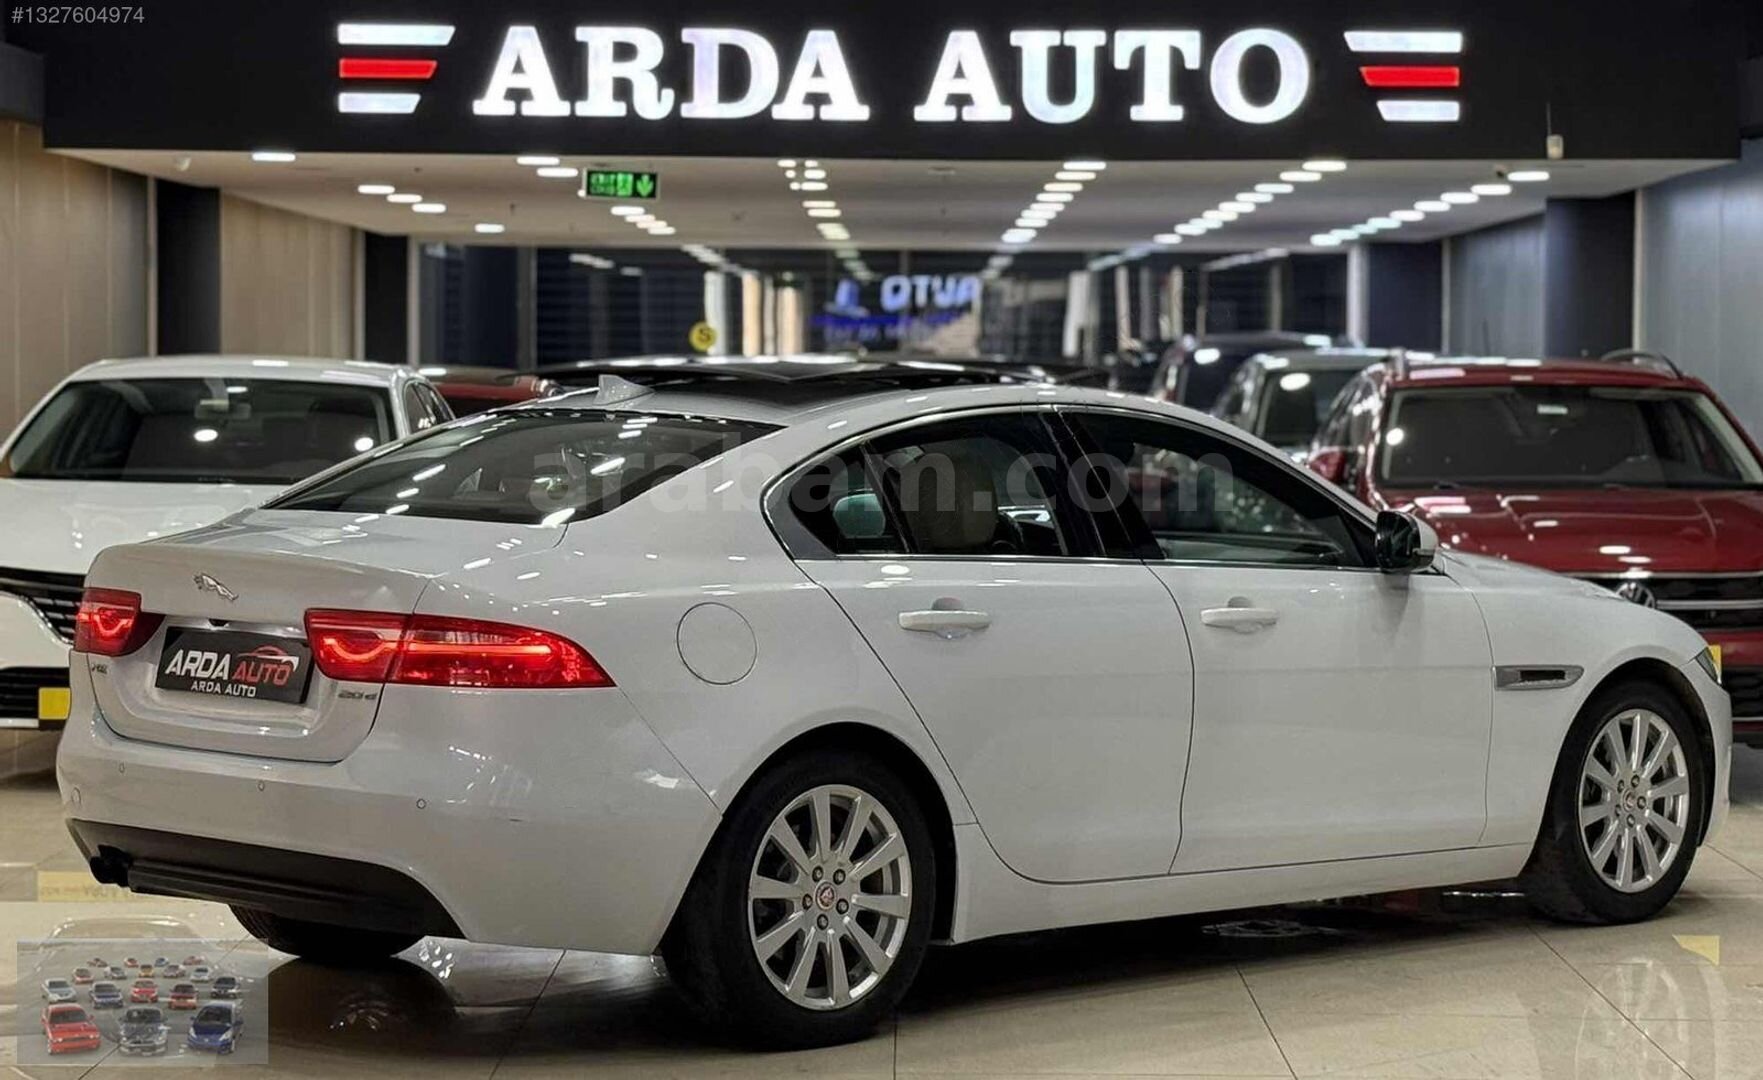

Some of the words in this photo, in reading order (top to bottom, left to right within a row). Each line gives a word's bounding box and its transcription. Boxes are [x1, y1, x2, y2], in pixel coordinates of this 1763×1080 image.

[472, 25, 871, 121] ARDA
[913, 28, 1311, 123] AUTO
[165, 649, 231, 681] ARDA
[232, 660, 291, 686] AUTO
[190, 680, 221, 694] ARDA
[224, 684, 257, 698] AUTO
